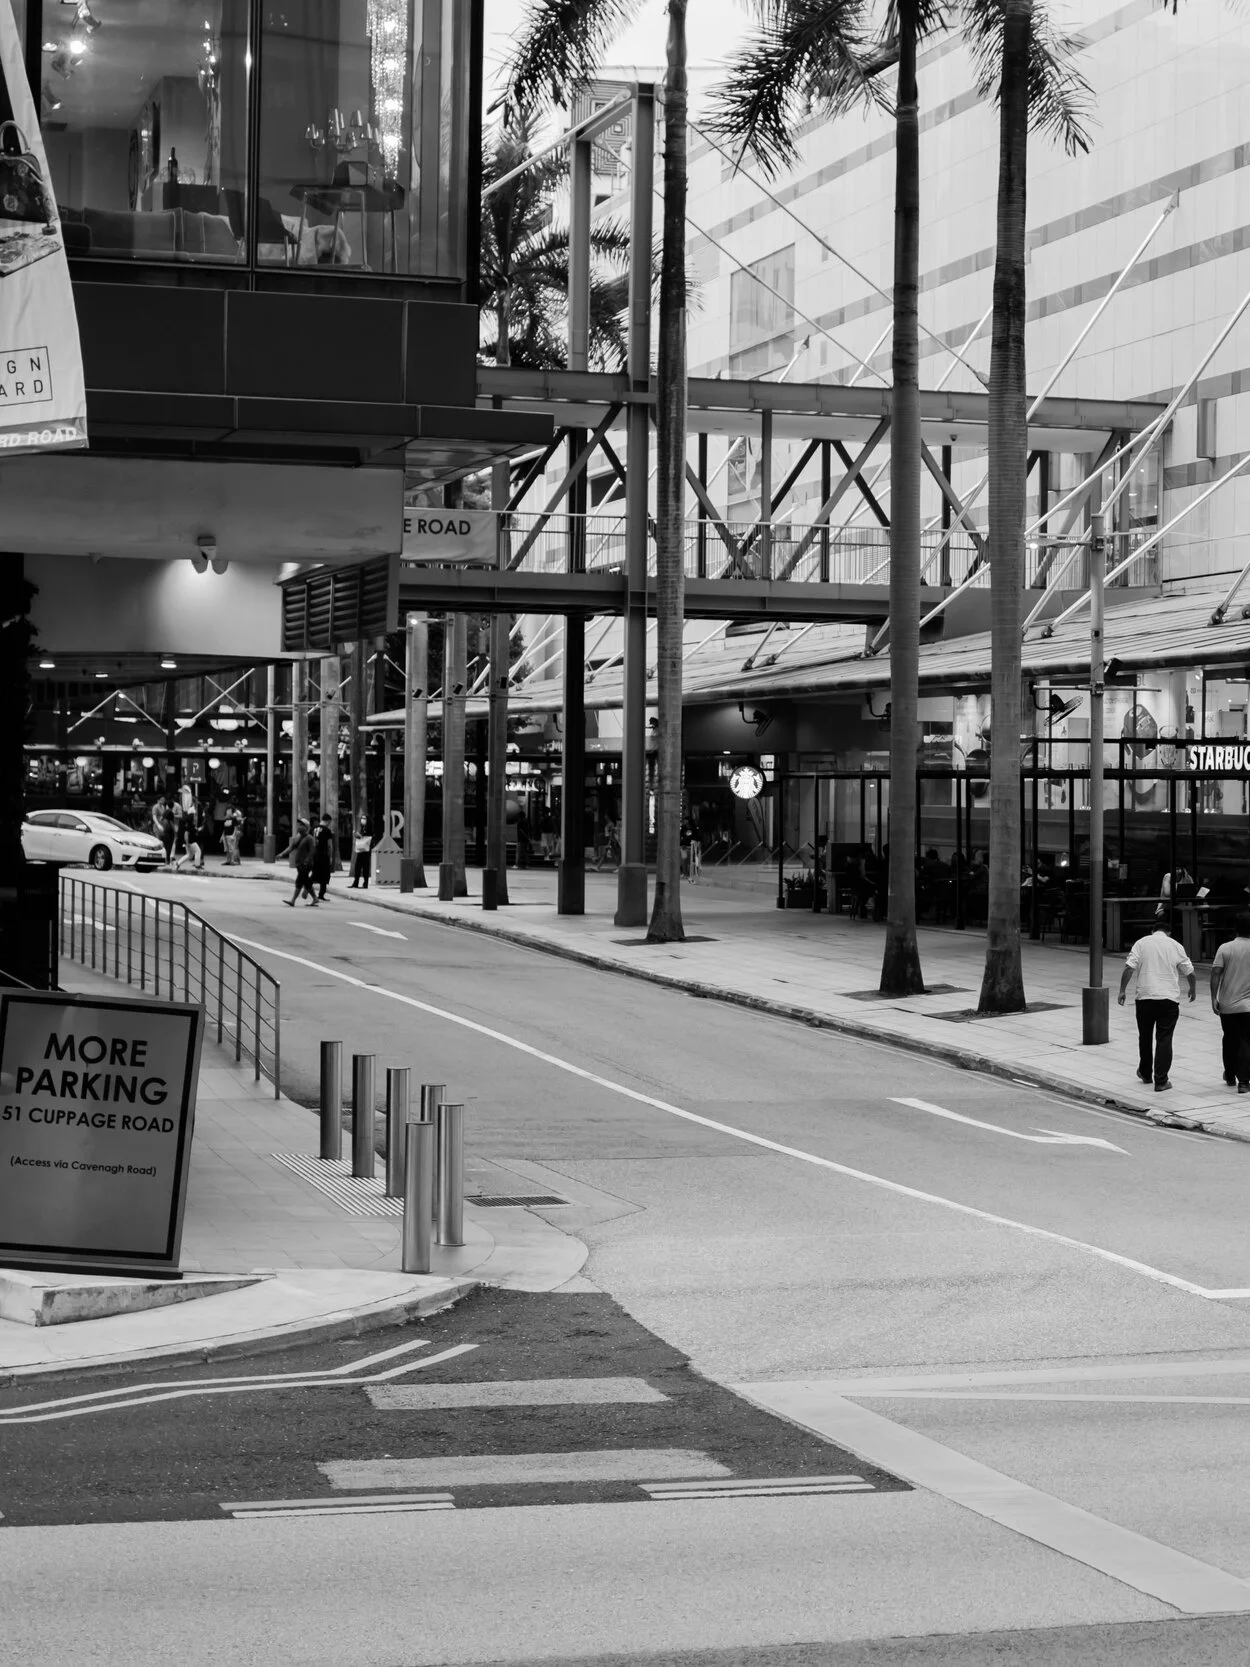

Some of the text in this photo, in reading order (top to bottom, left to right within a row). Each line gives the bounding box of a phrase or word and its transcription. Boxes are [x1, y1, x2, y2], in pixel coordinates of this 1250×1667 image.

[28, 427, 77, 445] ROAD
[418, 518, 471, 535] ROAD
[44, 1033, 148, 1068] MORE
[15, 1066, 168, 1106] PARKING
[2, 1105, 174, 1133] 51 CUPPAGE ROAD
[10, 1155, 157, 1177] (Access via Cavenagh Road)
